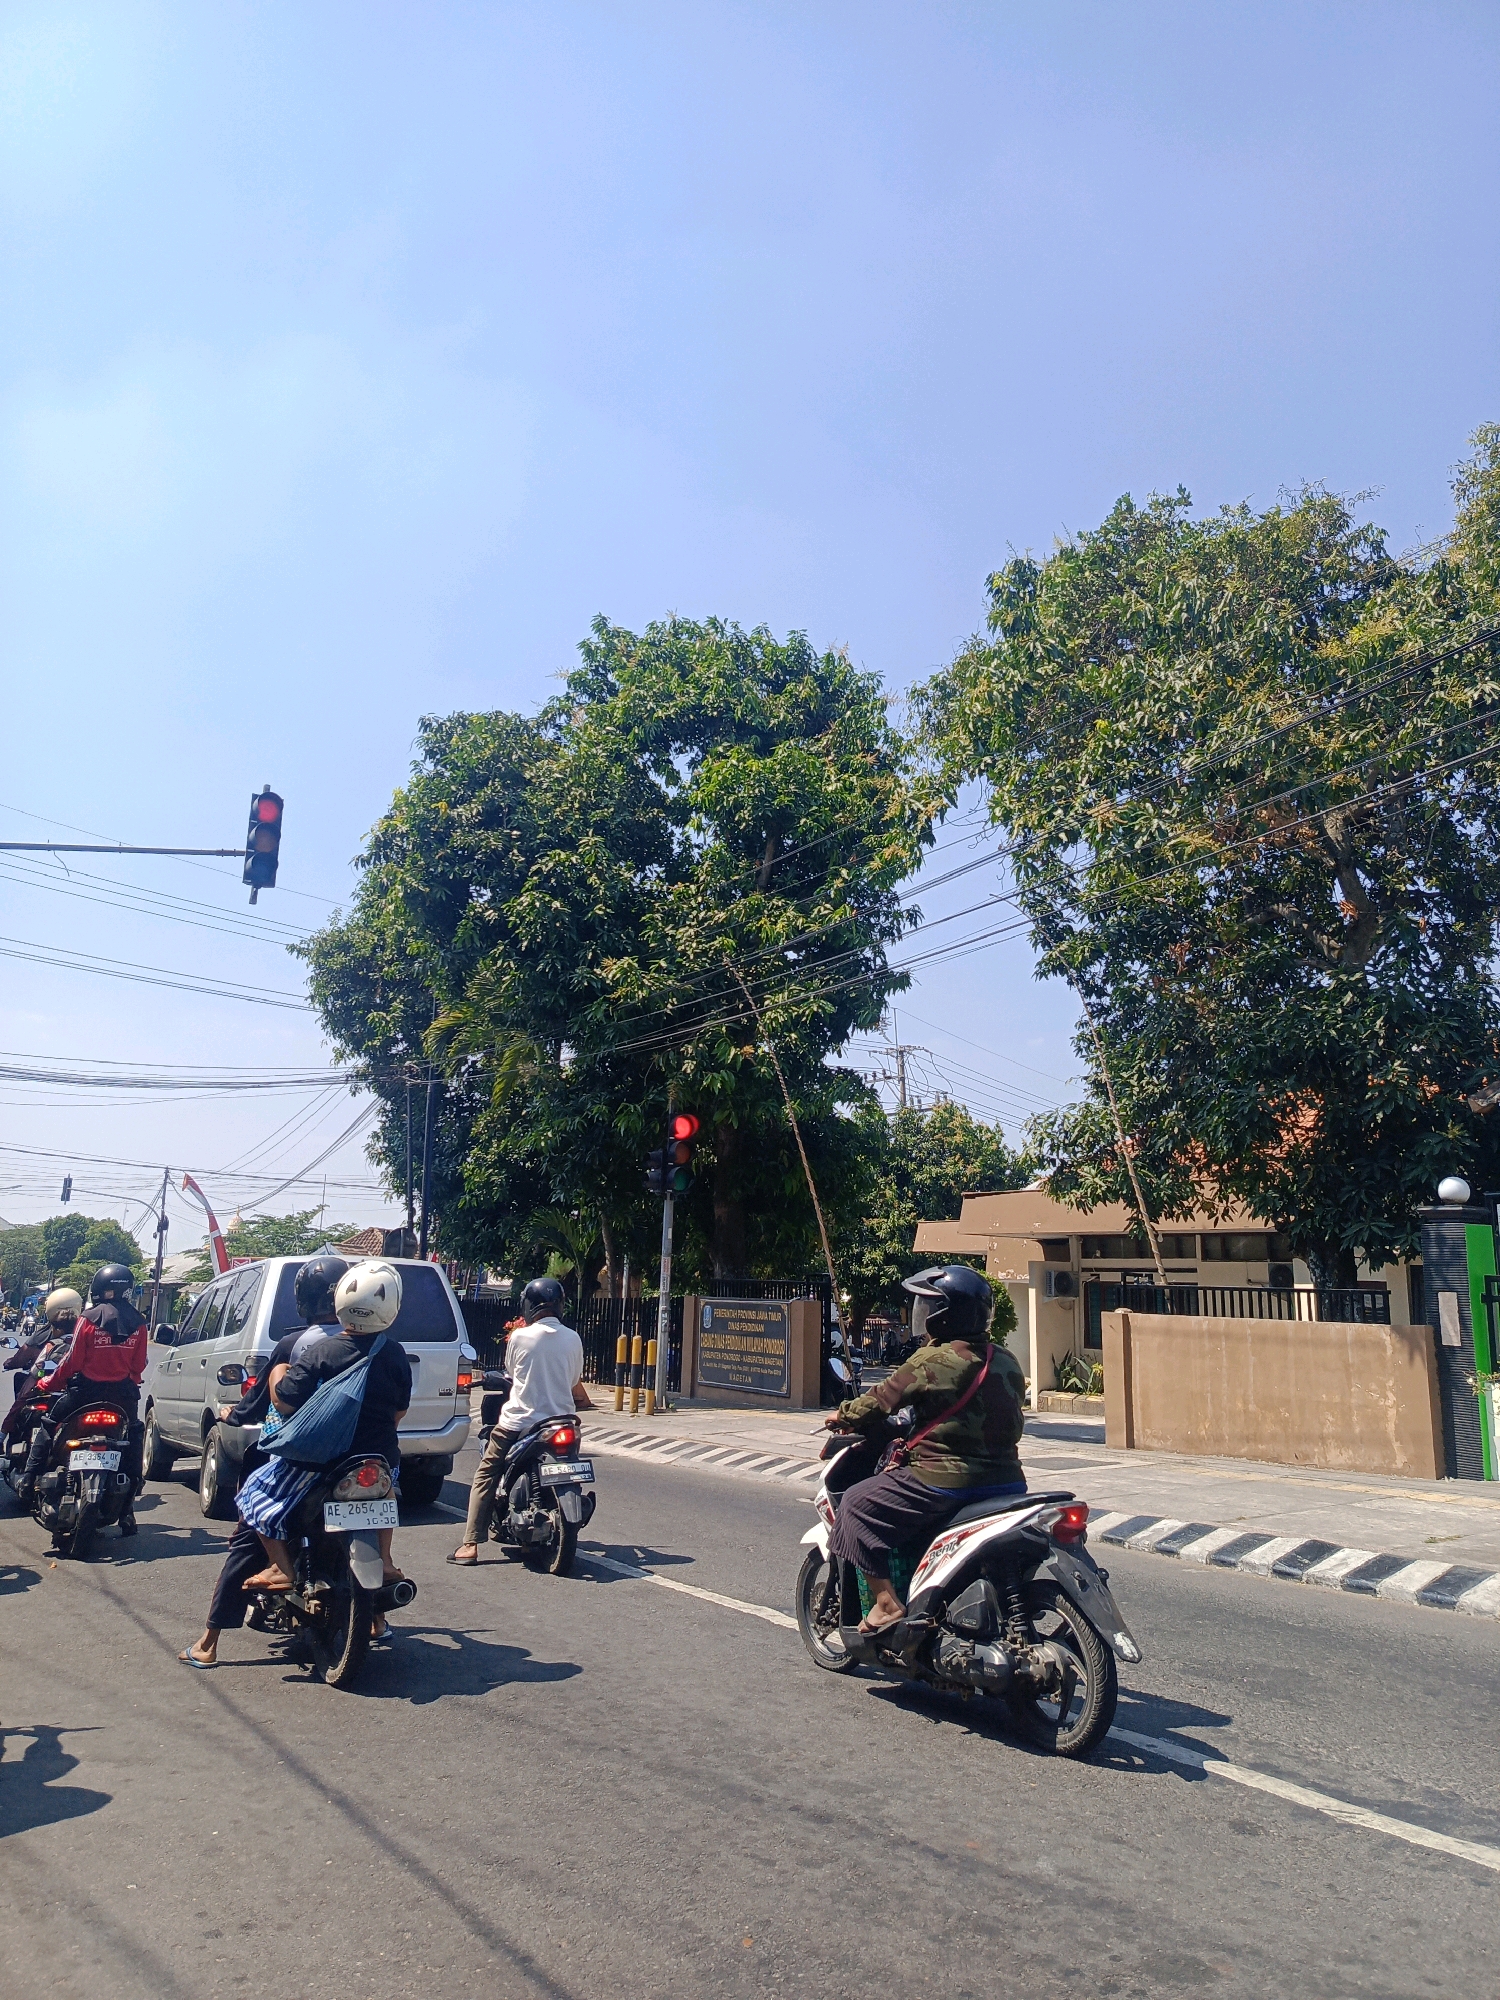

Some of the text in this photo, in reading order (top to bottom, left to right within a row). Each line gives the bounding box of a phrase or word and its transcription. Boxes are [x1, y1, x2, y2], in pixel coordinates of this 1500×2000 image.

[714, 1309, 781, 1321] PEMERINTAH PROVINSI JAWA TIMUR
[728, 1322, 764, 1332] DINAS PENDIDIKAN
[729, 1373, 751, 1383] MAGETAN
[73, 1453, 84, 1461] AE
[328, 1502, 395, 1516] AE 2654 OE
